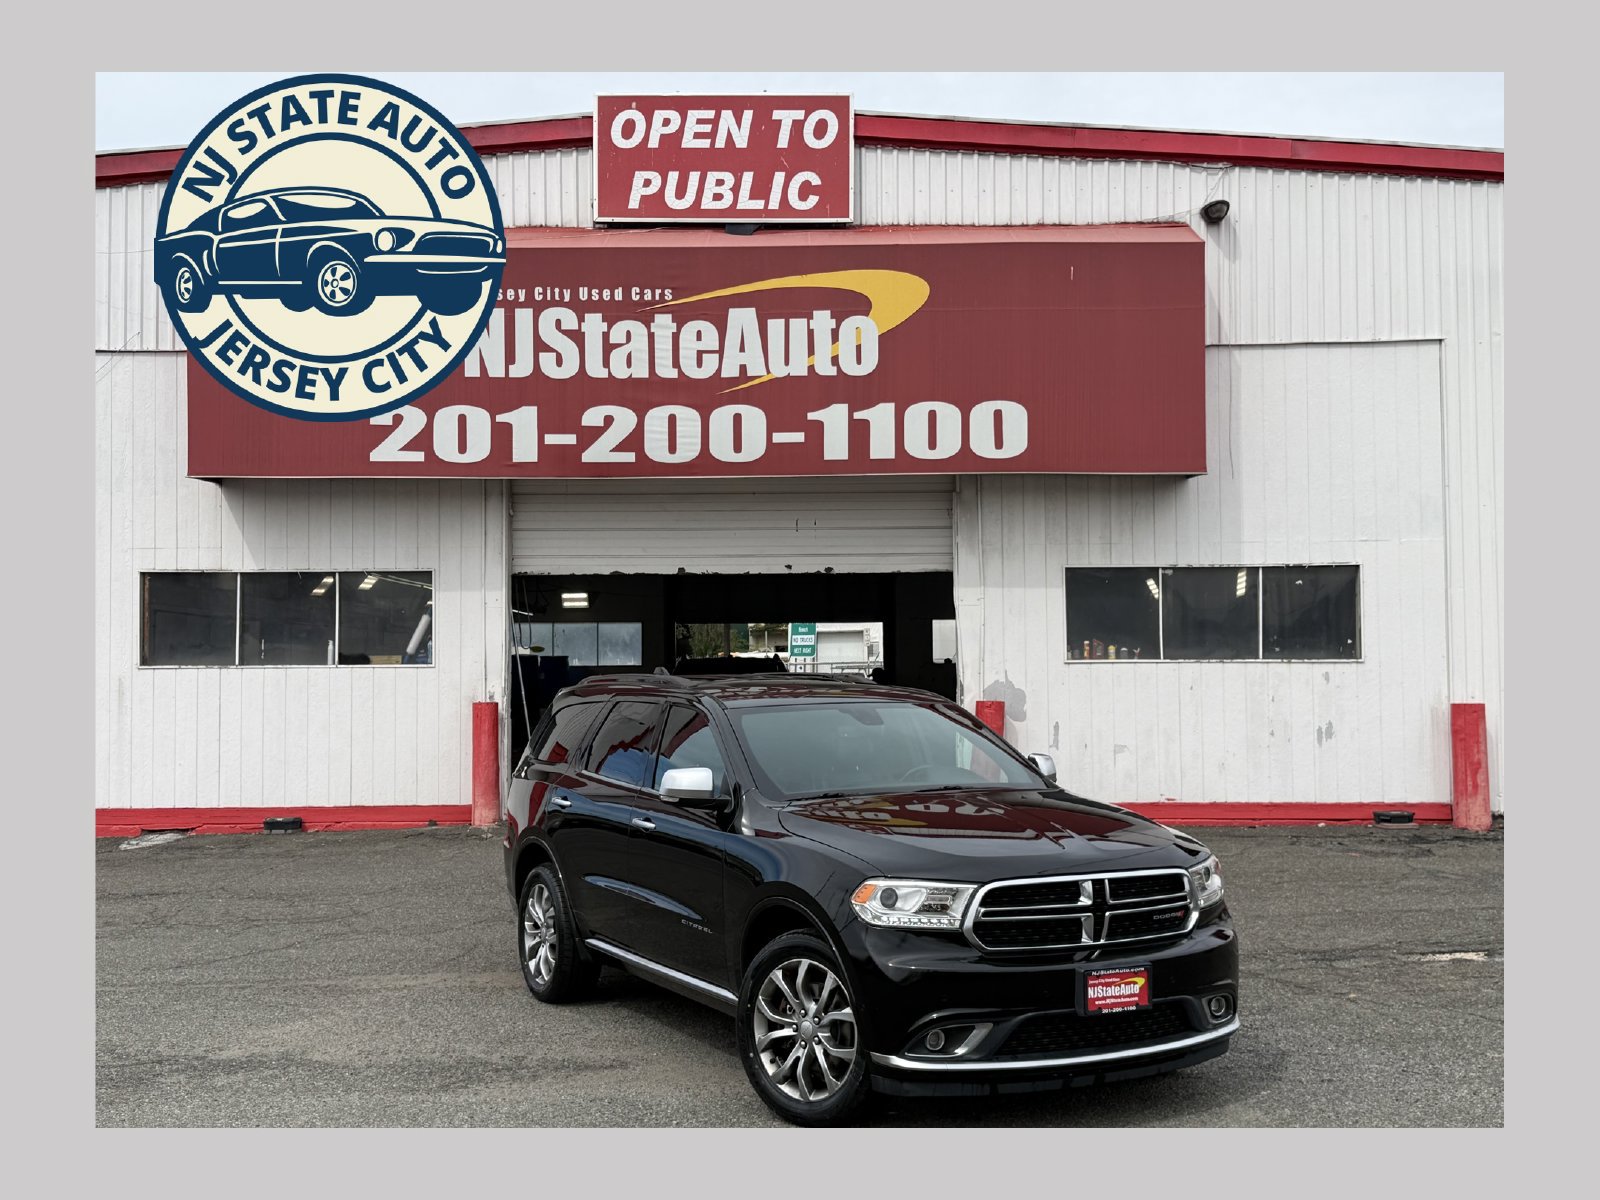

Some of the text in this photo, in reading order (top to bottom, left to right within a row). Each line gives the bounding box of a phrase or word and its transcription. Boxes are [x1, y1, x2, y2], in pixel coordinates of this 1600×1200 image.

[610, 109, 839, 150] OPEN TO
[627, 170, 823, 211] PUBLIC
[534, 286, 571, 302] City
[579, 286, 623, 301] Used
[631, 286, 673, 301] Cars
[464, 307, 879, 380] NJStateAuto
[369, 400, 1029, 464] 201-200-1100
[1088, 983, 1140, 999] NJStateAuto
